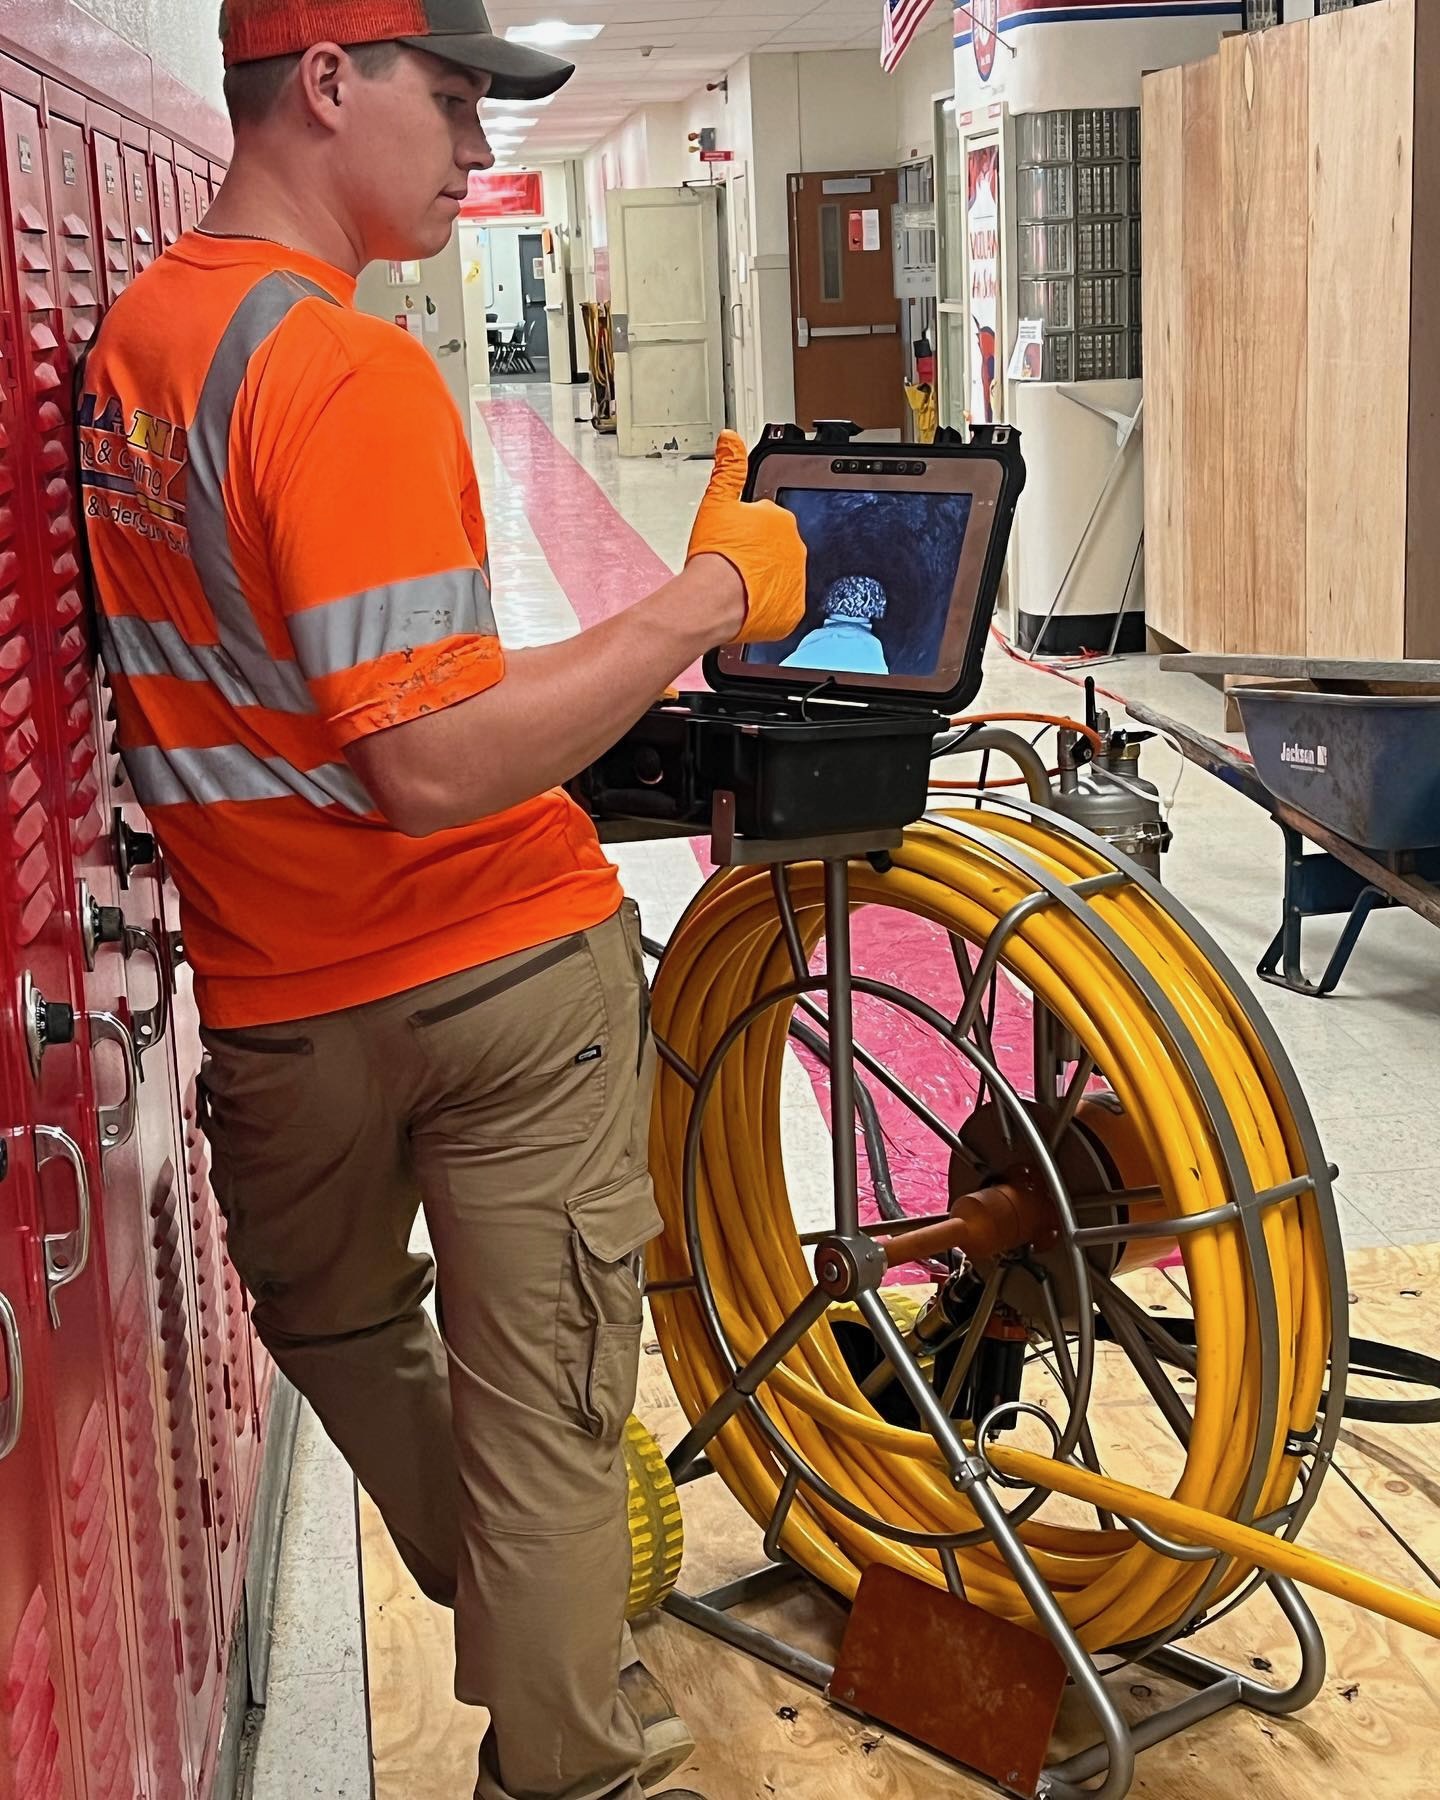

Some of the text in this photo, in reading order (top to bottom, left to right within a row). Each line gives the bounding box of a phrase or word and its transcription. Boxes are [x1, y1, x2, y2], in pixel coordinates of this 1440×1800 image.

[97, 439, 113, 464] &
[87, 495, 101, 516] &
[1280, 741, 1315, 765] Jackson
